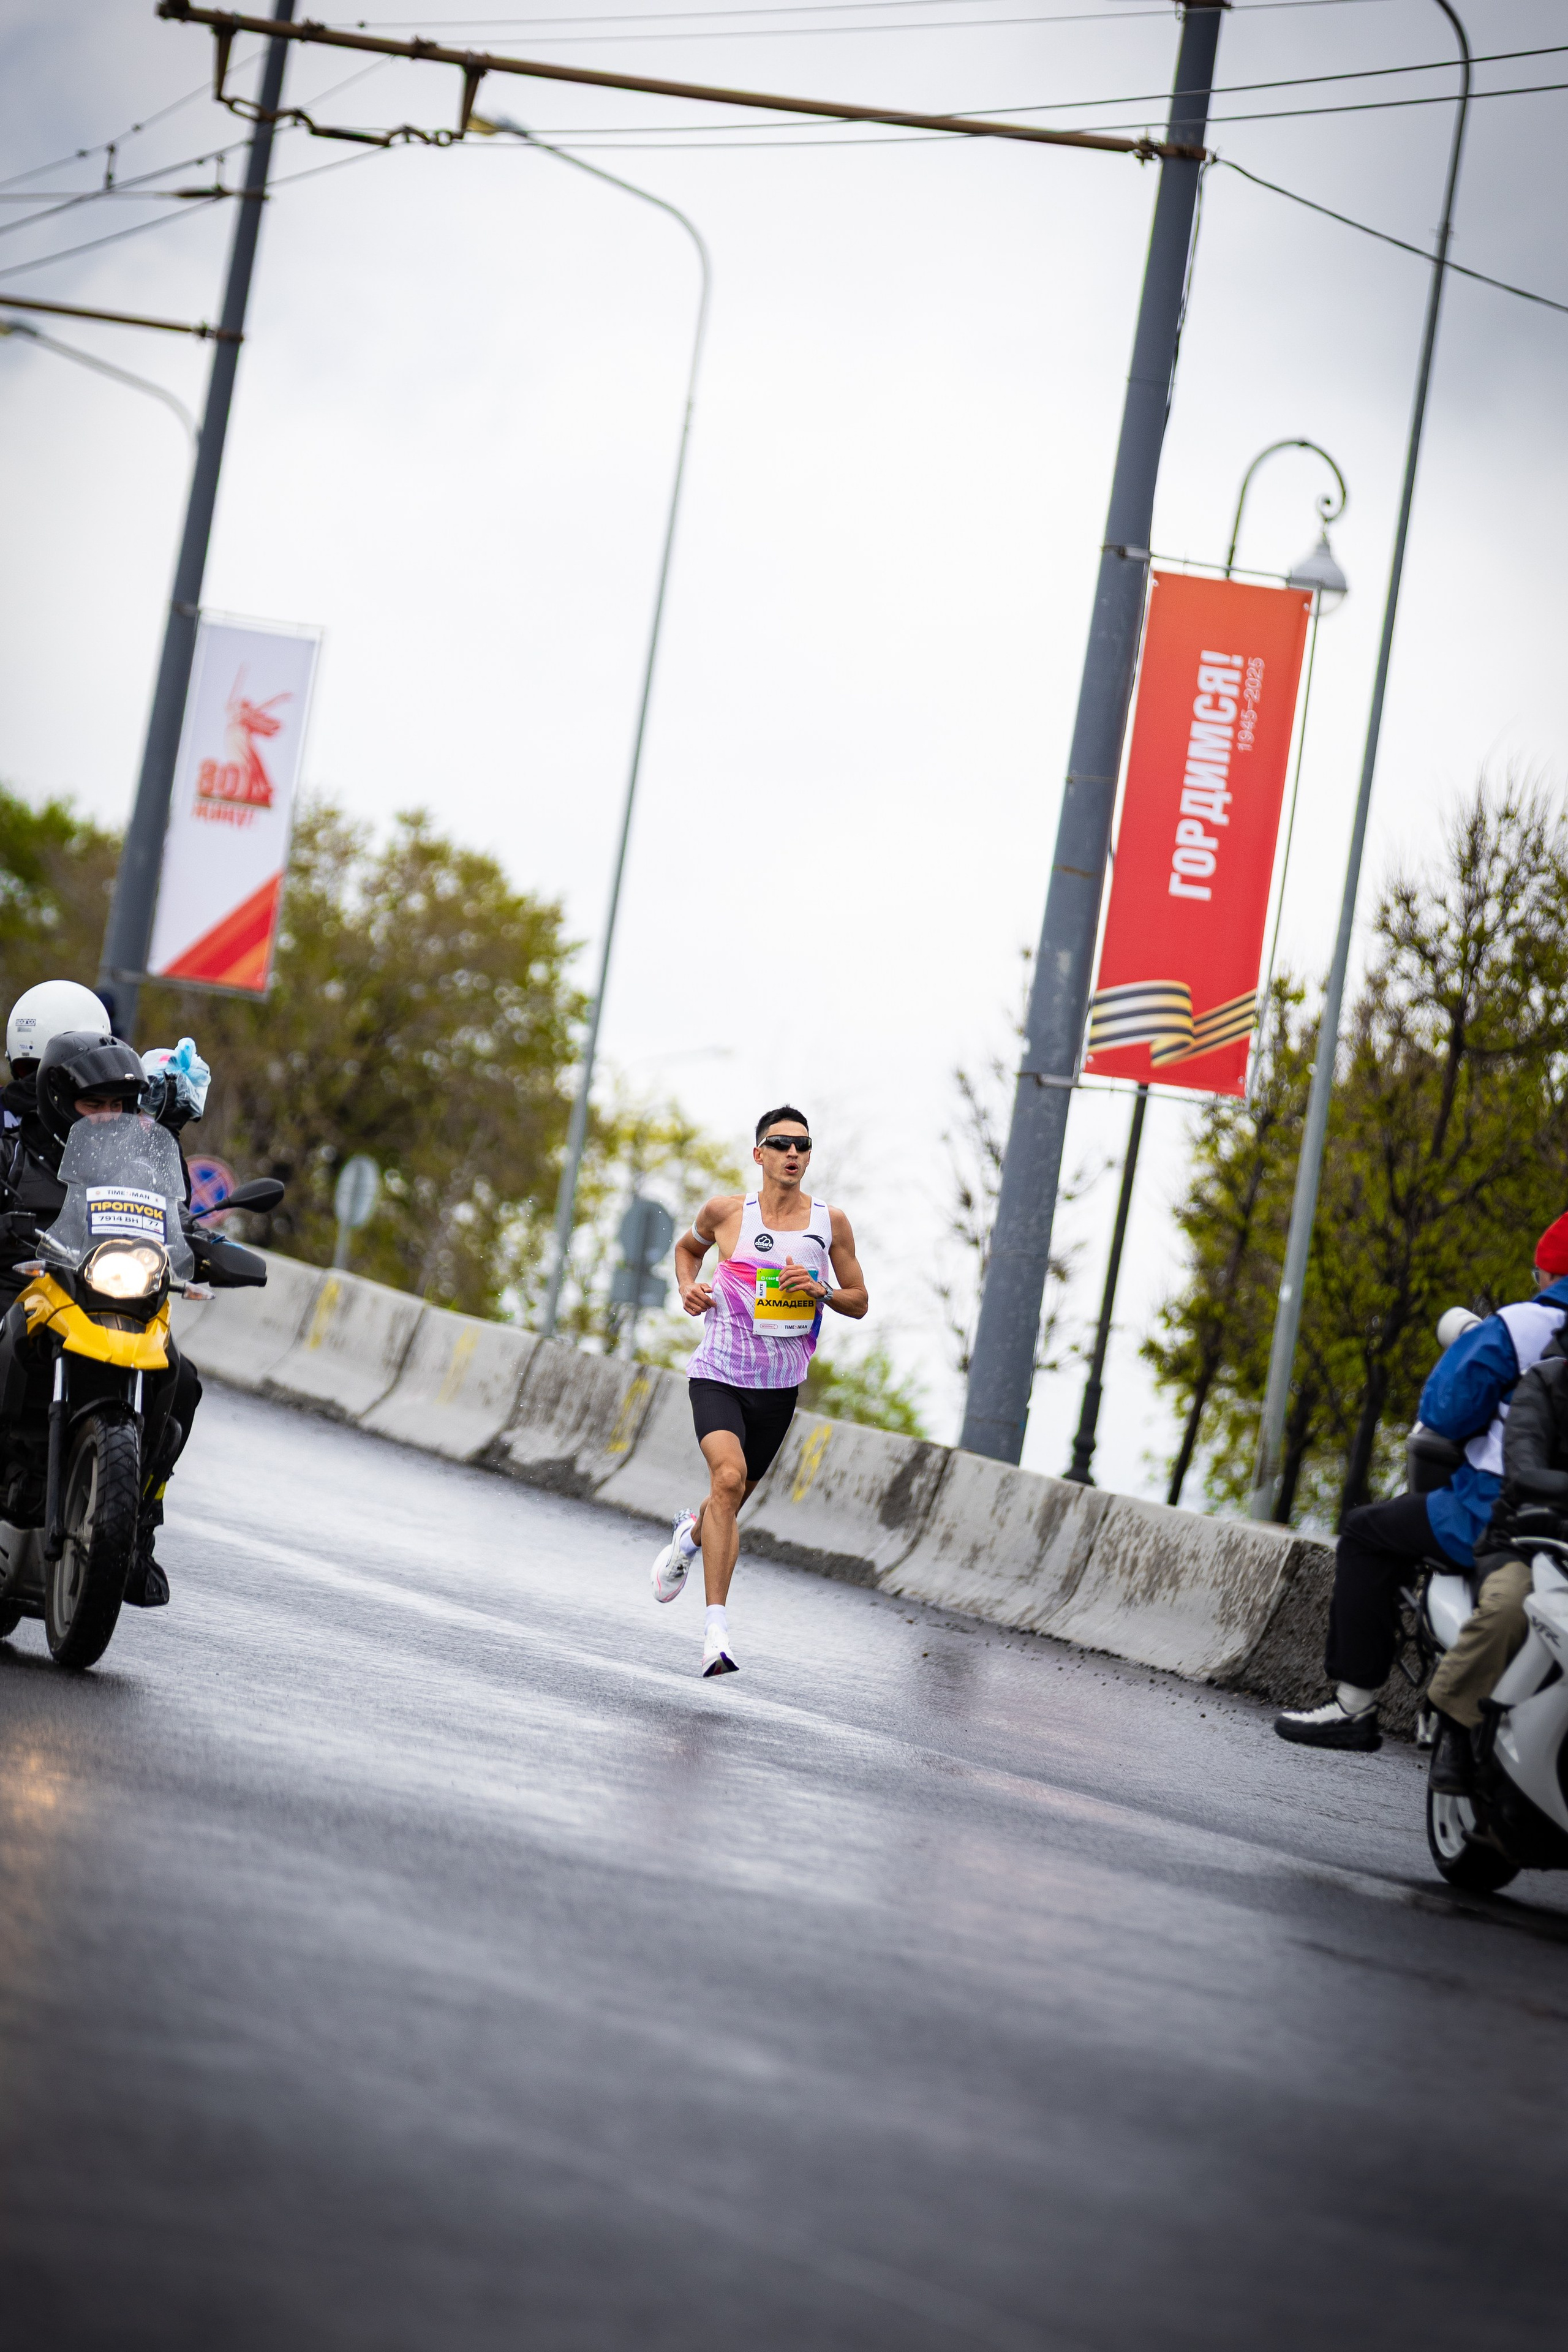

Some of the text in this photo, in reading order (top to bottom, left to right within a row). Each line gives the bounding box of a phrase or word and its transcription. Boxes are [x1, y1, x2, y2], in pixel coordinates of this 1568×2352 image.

[1168, 649, 1244, 901] ГОРДИМСЯ!
[91, 1202, 164, 1220] ПРОПУСК
[757, 1299, 814, 1308] АХМАДЕЕВ
